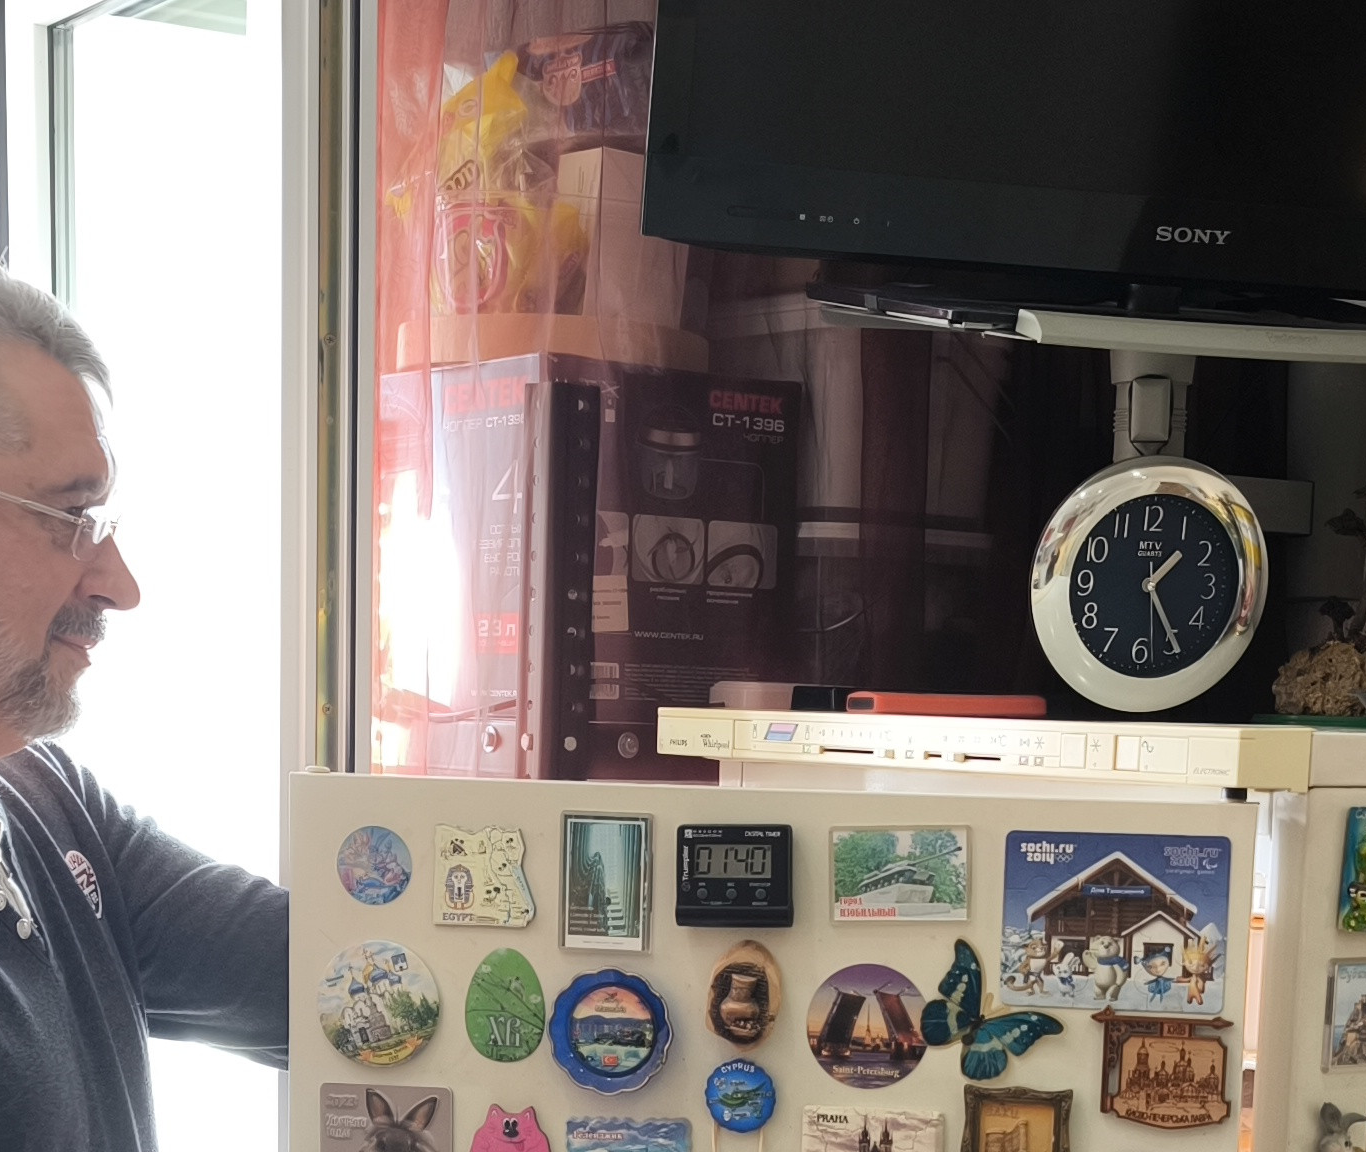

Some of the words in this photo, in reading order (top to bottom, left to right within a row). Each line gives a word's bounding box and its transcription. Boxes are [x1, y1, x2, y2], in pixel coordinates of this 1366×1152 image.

[1156, 226, 1231, 245] SONY
[709, 390, 783, 414] CENTEK
[712, 412, 785, 432] CT-1396
[1114, 513, 1130, 538] 11
[1144, 505, 1164, 532] 12
[1086, 536, 1109, 563] 10
[1139, 541, 1162, 551] MTV
[1197, 541, 1213, 567] 2
[1077, 570, 1094, 596] 9
[1200, 574, 1216, 600] 3
[1081, 602, 1098, 629] 8
[1188, 606, 1205, 630] 4
[1103, 627, 1119, 653] 7
[1131, 638, 1148, 664] 6
[669, 739, 687, 747] PHILIPS
[1020, 840, 1074, 853] sochi.ru
[1026, 852, 1055, 864] 2014
[443, 913, 473, 921] EGYPT
[720, 1062, 755, 1073] CYPRUS
[832, 1065, 900, 1078] Saint-Petersburg
[816, 1114, 849, 1124] PRAHA
[573, 1130, 623, 1140] Геленджик
